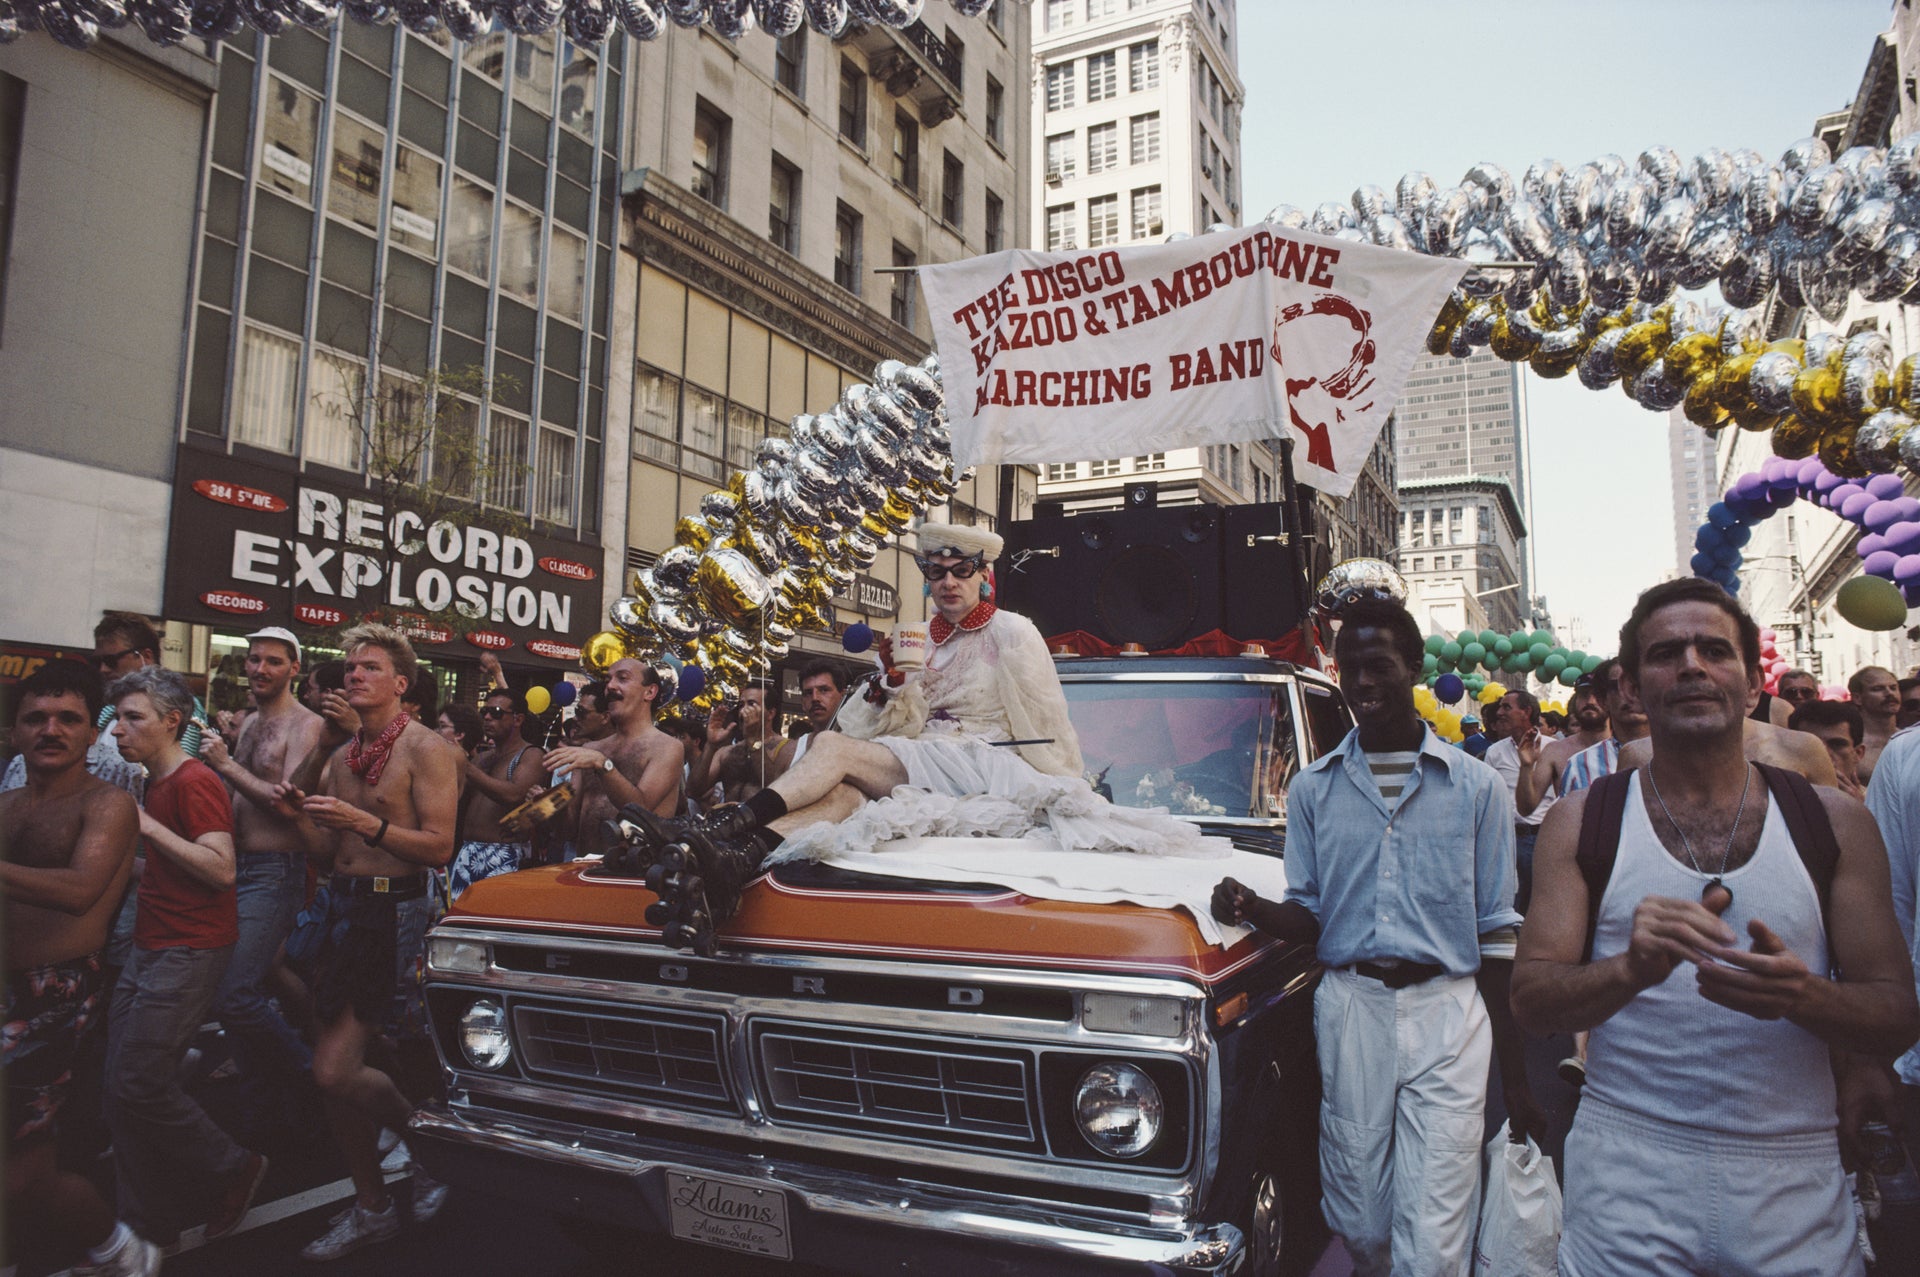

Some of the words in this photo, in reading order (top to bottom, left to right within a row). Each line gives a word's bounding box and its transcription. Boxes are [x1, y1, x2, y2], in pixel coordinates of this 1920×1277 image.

[953, 273, 1020, 340] THE
[1021, 251, 1125, 305] DISCO
[971, 306, 1078, 377] KAZOO
[1083, 300, 1110, 336] &
[1102, 231, 1340, 330] TAMBOURINE
[973, 363, 1151, 417] MARCHING
[1169, 338, 1263, 391] BAND
[210, 484, 232, 499] 384
[298, 487, 534, 579] RECORD
[231, 530, 571, 634] EXPLOSION
[548, 560, 586, 577] CLASSICAL
[206, 593, 264, 611] RECORDS
[860, 582, 893, 611] BAZAAR
[301, 607, 341, 623] TAPES
[475, 633, 506, 647] VIDEO
[532, 641, 581, 658] ACCESSORIES
[546, 953, 985, 1006] FORD
[673, 1181, 777, 1223] Adams
[691, 1219, 728, 1237] Auto
[730, 1224, 765, 1243] Sales
